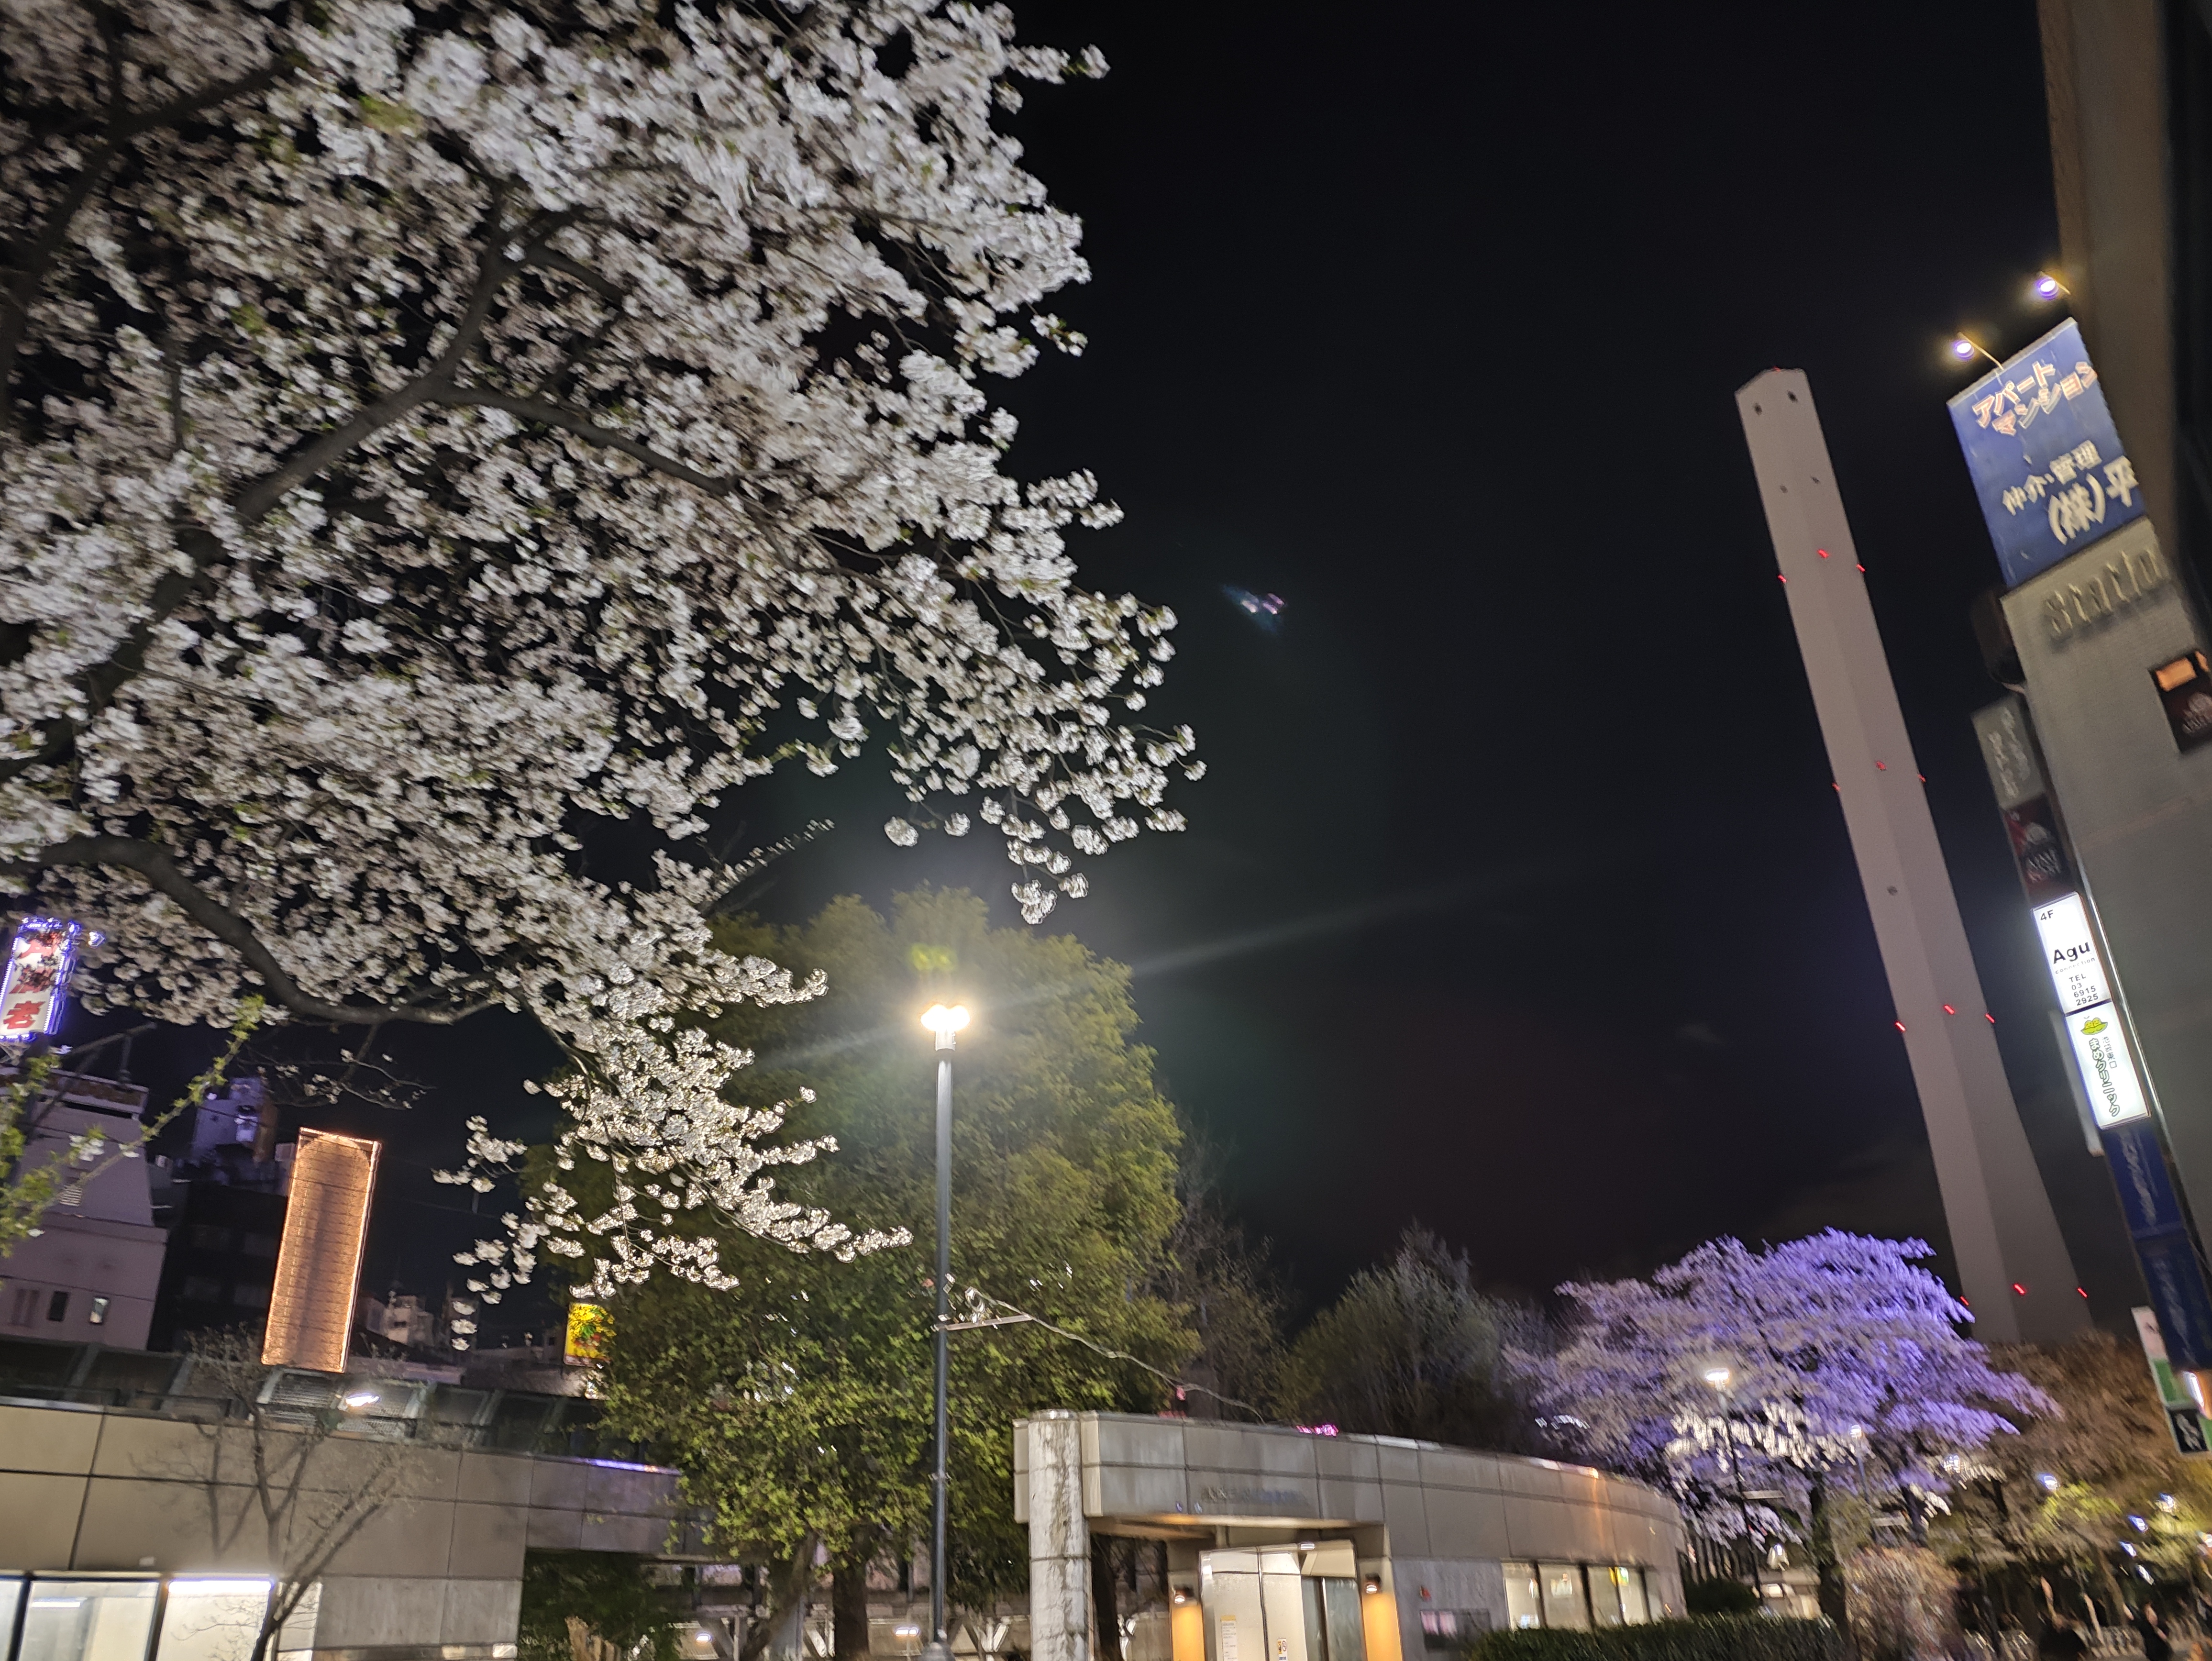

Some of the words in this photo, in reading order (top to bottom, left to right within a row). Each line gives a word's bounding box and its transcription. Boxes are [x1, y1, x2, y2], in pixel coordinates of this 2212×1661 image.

[1972, 361, 2056, 429] アパート
[1991, 362, 2098, 436] マンション
[2040, 910, 2054, 921] 4F
[2053, 941, 2090, 965] Agu
[2069, 974, 2086, 983] TEL
[2074, 986, 2096, 998] 6915
[2076, 993, 2099, 1006] 2925
[2102, 1036, 2117, 1069] 池袋東口
[2089, 1038, 2120, 1117] まめクリニック
